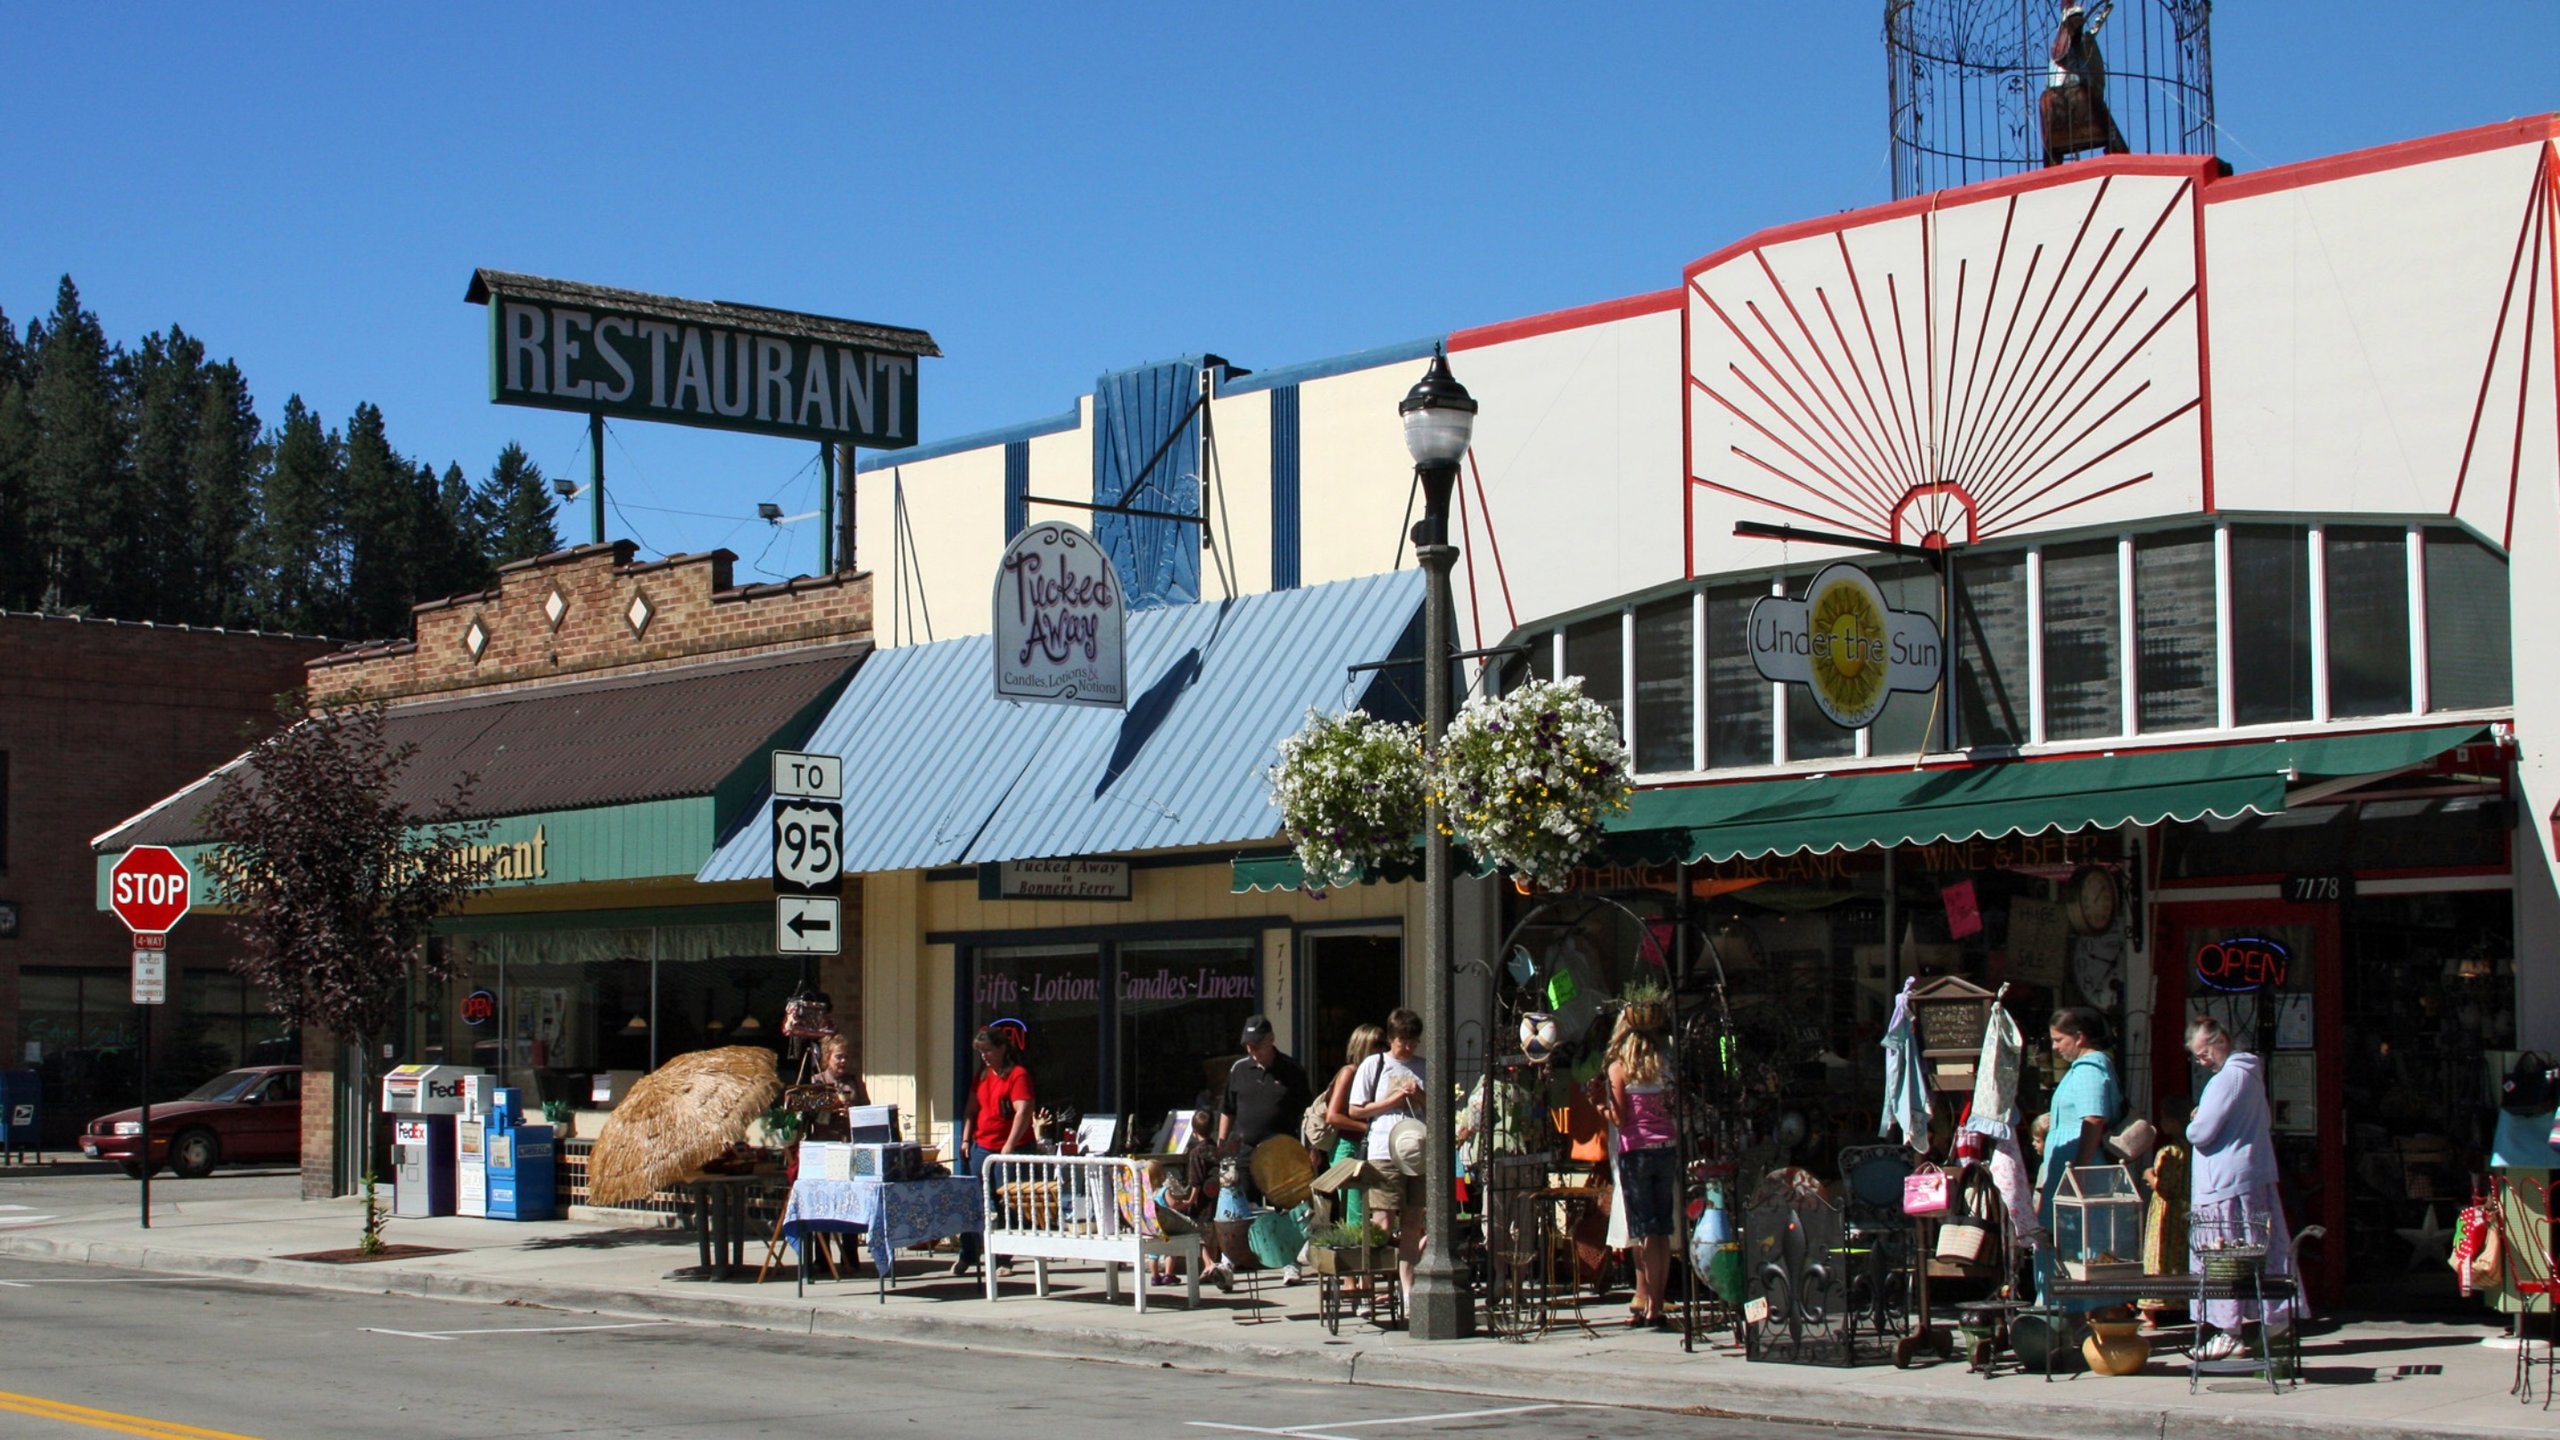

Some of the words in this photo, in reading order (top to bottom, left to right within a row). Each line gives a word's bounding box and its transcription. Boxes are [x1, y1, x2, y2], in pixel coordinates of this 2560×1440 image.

[504, 302, 913, 438] RESTAURANT
[1004, 552, 1113, 625] Tucked
[1020, 607, 1098, 666] Away
[1756, 610, 1838, 661] Under
[1844, 612, 1885, 661] the
[1890, 632, 1937, 667] Sun
[1004, 671, 1048, 688] Candles,
[1049, 666, 1087, 687] Lotions
[1087, 665, 1098, 681] &
[1079, 680, 1117, 694] Notions
[792, 764, 823, 789] TO
[784, 822, 832, 873] 95
[1922, 842, 1986, 872] WINE
[1995, 840, 2014, 870] &
[1014, 860, 1072, 873] Tucked
[1077, 861, 1119, 875] Away
[1063, 874, 1072, 883] in
[1714, 853, 1861, 881] ORGANIC
[116, 872, 184, 905] STOP
[1018, 881, 1074, 894] Bonners
[1080, 881, 1115, 895] Ferry
[2296, 878, 2339, 898] 7178
[137, 936, 163, 946] 4-WAY
[1276, 943, 1285, 1011] 7174
[2197, 944, 2286, 985] OPEN
[974, 973, 1018, 1009] Gifts
[1115, 968, 1188, 1000] Candles
[461, 997, 492, 1018] OPEN
[429, 1081, 466, 1097] FedE
[399, 1123, 425, 1139] FedEx
